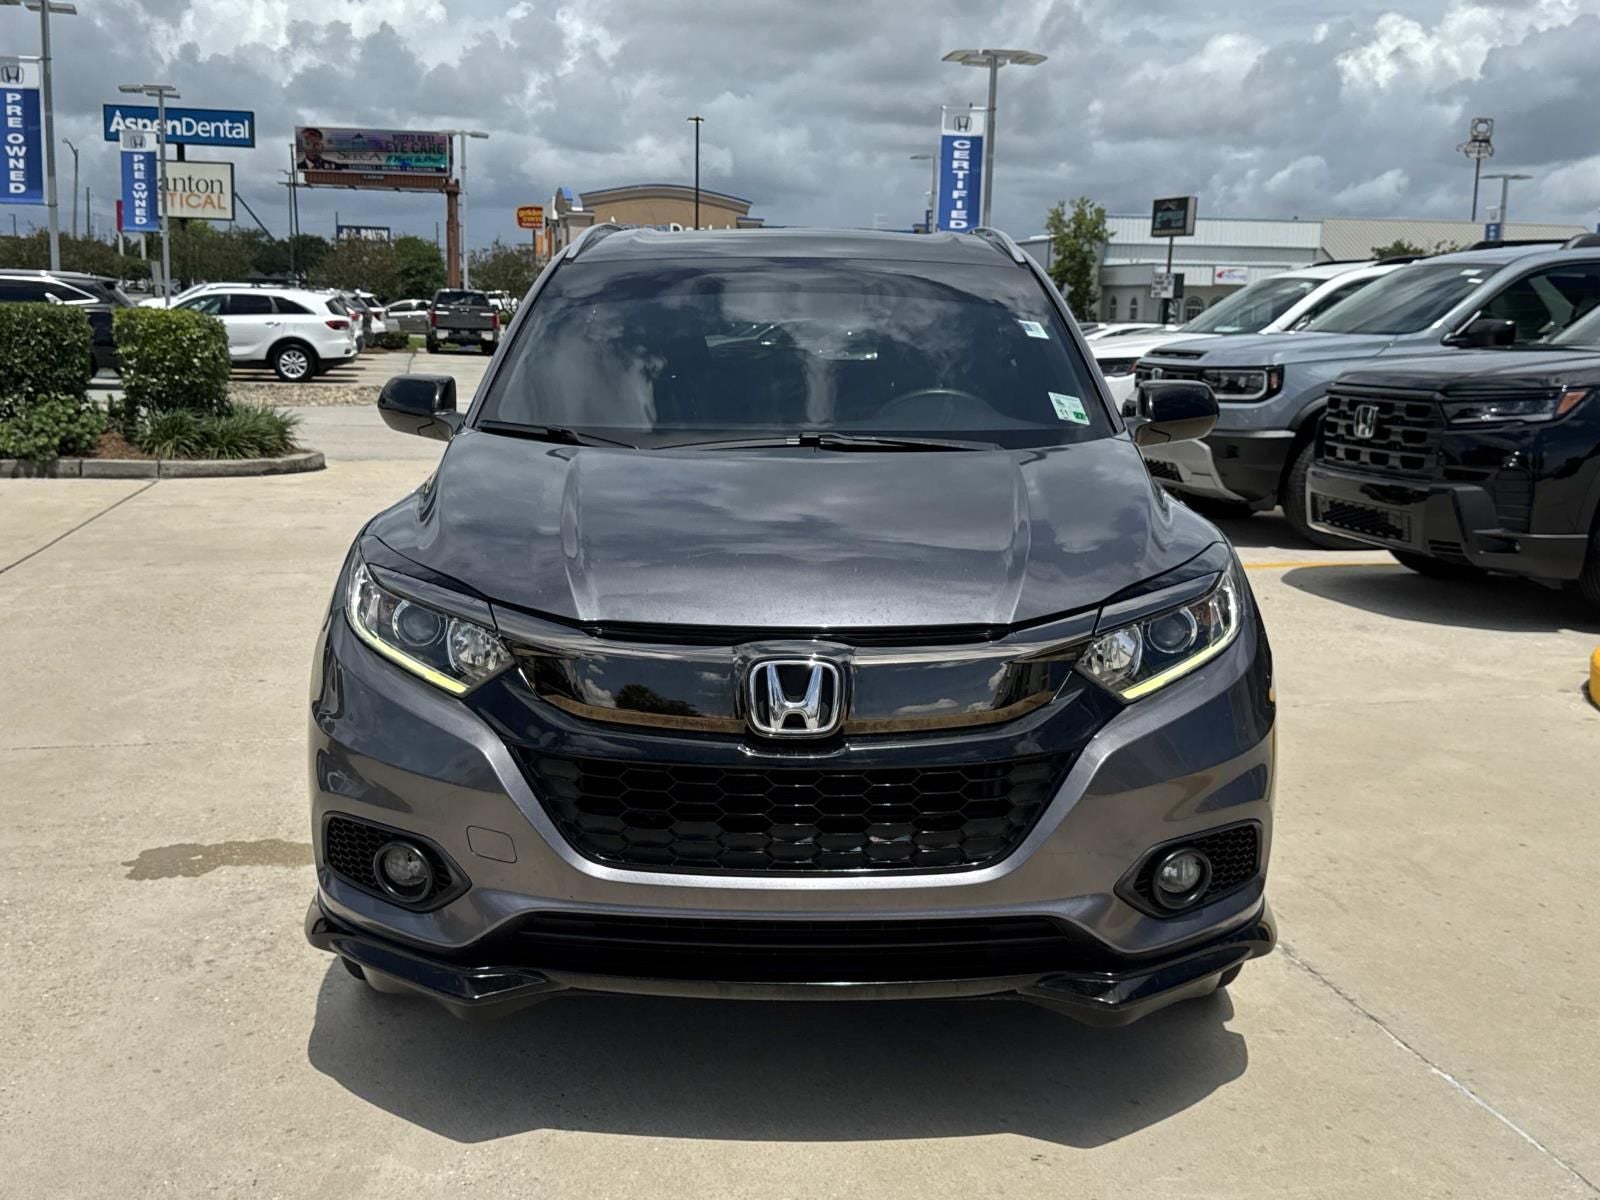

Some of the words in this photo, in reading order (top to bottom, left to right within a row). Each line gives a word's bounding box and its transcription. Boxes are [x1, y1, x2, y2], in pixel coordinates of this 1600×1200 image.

[6, 93, 22, 128] PRE
[5, 133, 27, 194] OWNED
[133, 154, 145, 179] PRE
[158, 174, 224, 194] anton
[159, 193, 227, 210] TICAL
[949, 139, 972, 229] CERTIFIED
[132, 182, 148, 225] OWNED
